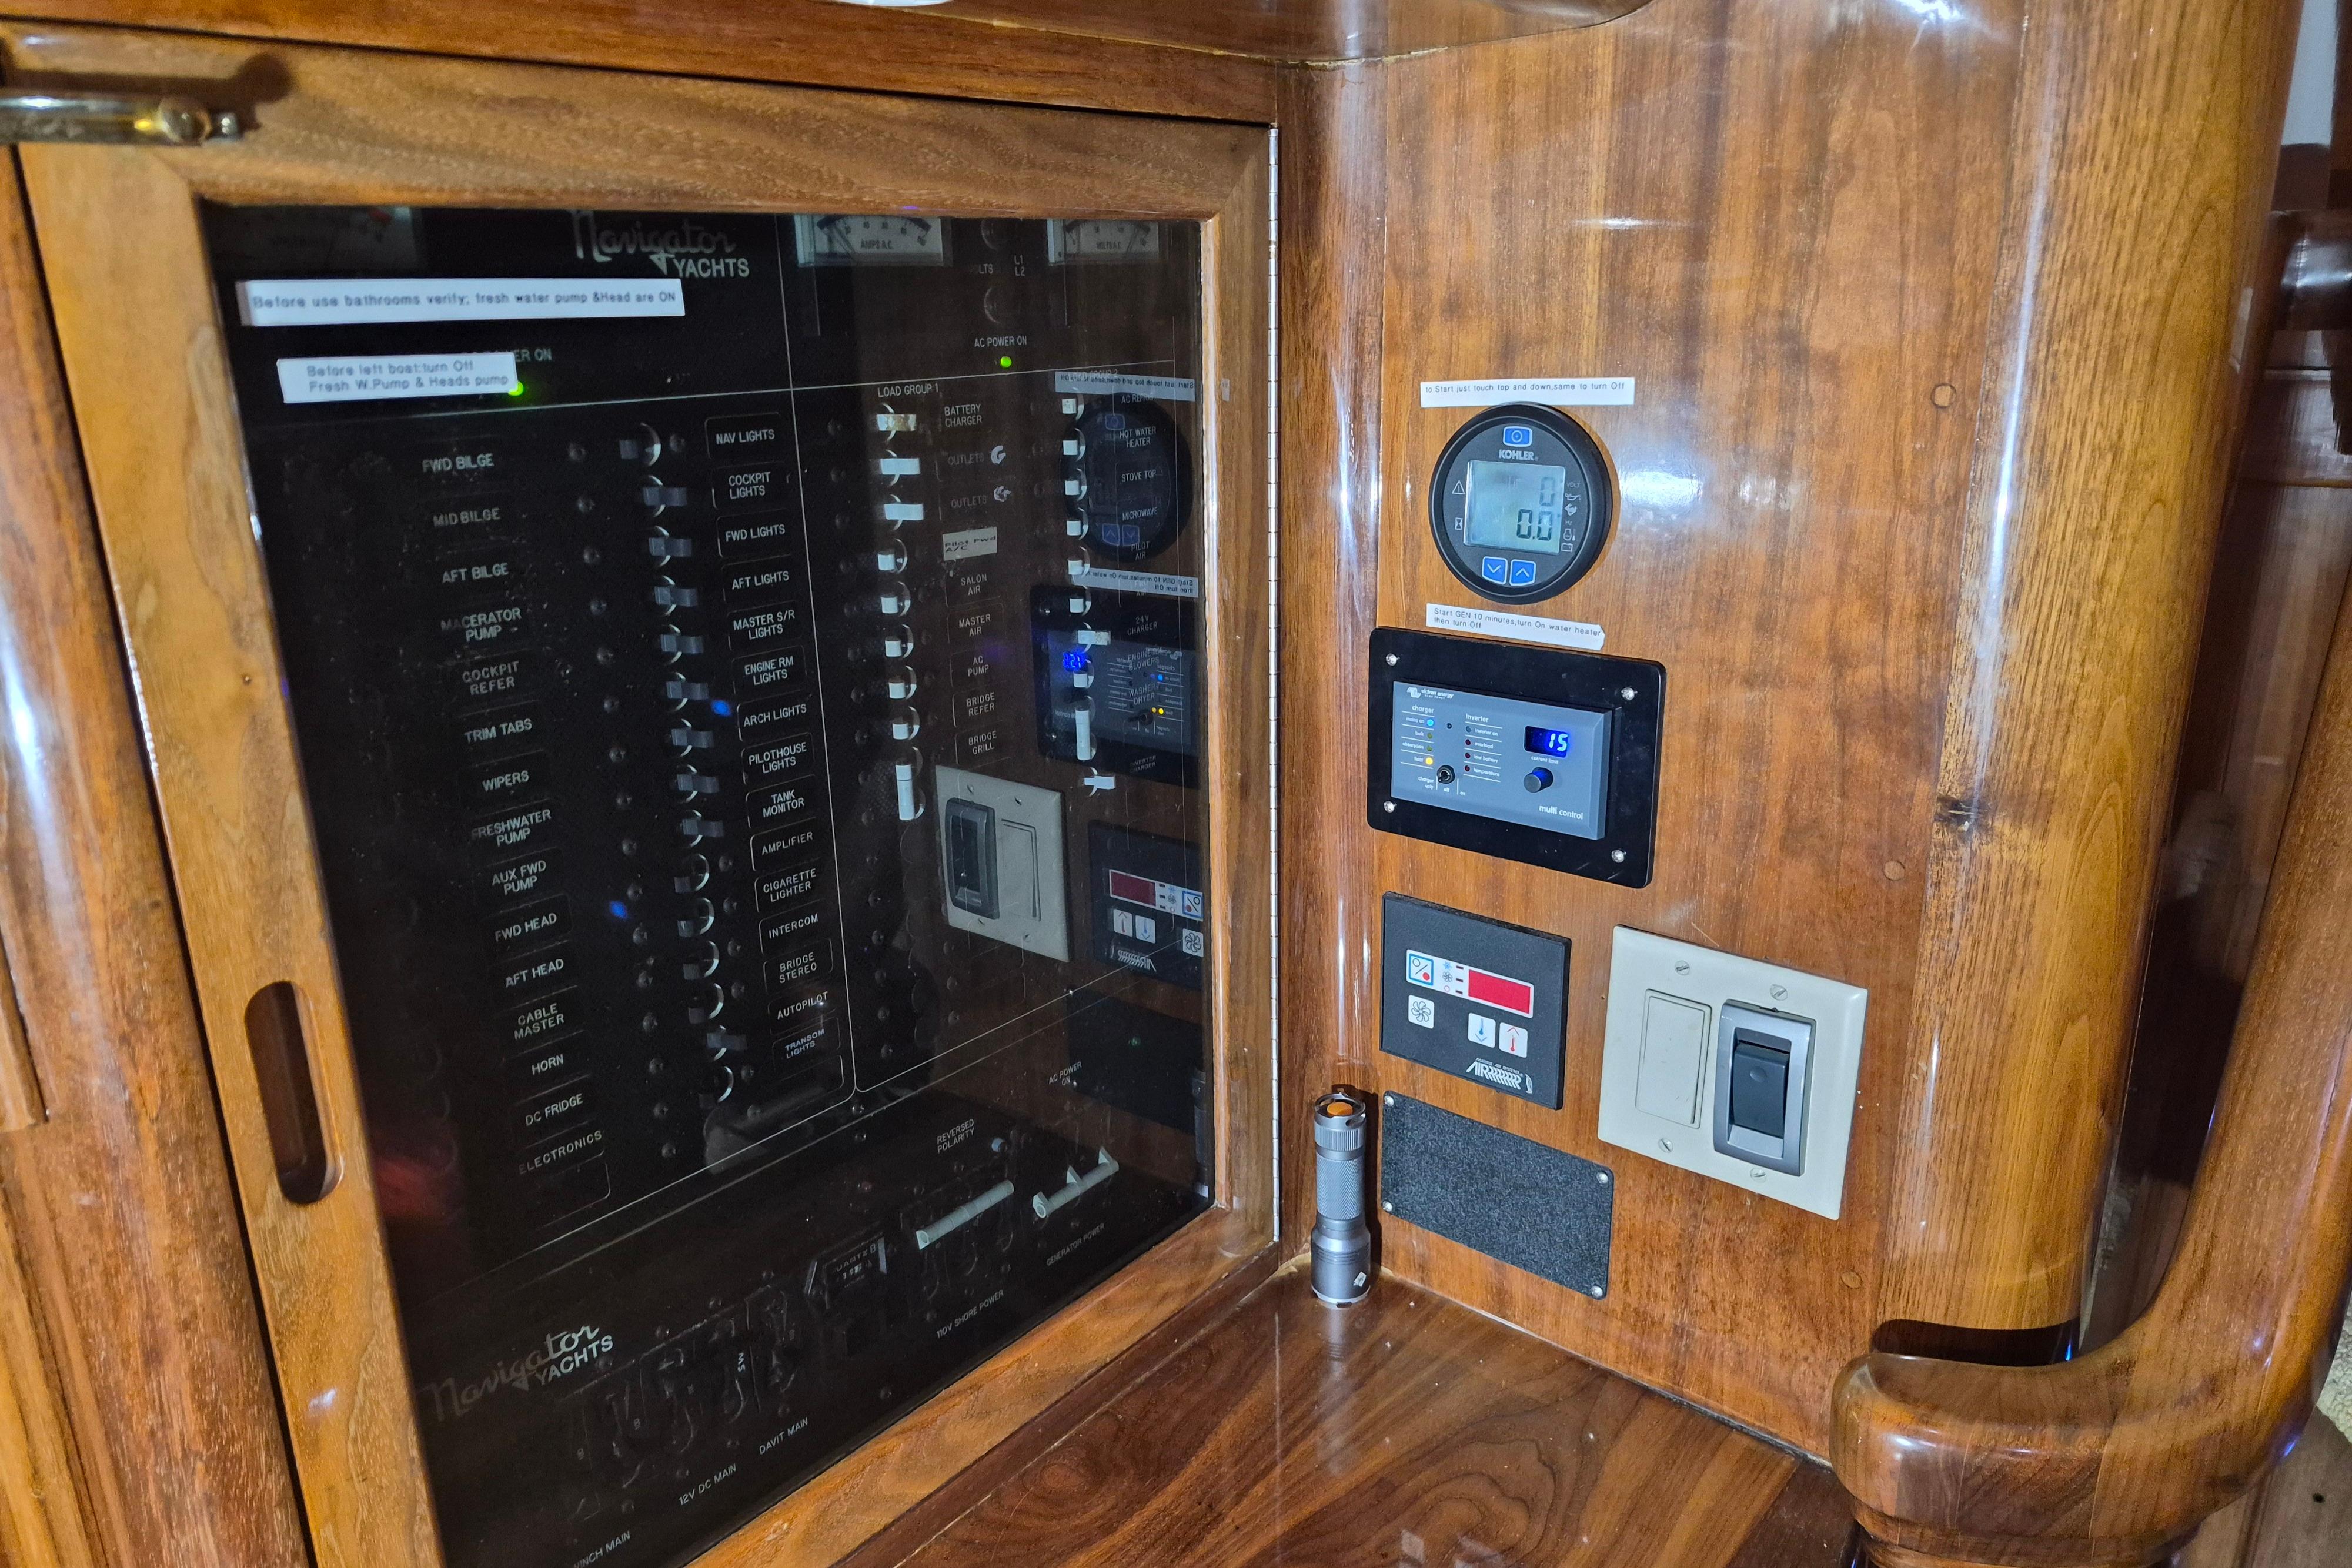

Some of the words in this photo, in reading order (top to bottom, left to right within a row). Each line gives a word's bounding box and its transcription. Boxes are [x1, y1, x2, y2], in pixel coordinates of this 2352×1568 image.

[674, 258, 750, 277] YACHTS
[1015, 266, 1025, 276] L2
[253, 295, 306, 308] Before
[312, 296, 338, 307] use
[344, 294, 420, 306] bathrooms
[476, 293, 509, 303] fresh
[515, 293, 548, 303] water
[555, 293, 587, 303] pump
[636, 293, 654, 303] are
[659, 291, 676, 302] ON
[974, 338, 985, 348] AC
[987, 337, 1014, 347] POWER
[1017, 336, 1027, 346] ON
[307, 365, 354, 377] Before
[359, 363, 382, 375] left
[453, 360, 473, 372] Off
[309, 380, 349, 392] Fresh
[416, 376, 424, 388] &
[429, 375, 469, 387] Heads
[475, 376, 509, 386] pump
[878, 386, 901, 398] LOAD
[904, 384, 932, 395] GROUP
[934, 383, 939, 393] 1
[1456, 385, 1471, 393] just
[944, 403, 981, 417] BATTERY
[945, 414, 983, 428] CHARGER
[716, 432, 736, 445] NAV
[739, 429, 775, 443] LIGHTS
[1126, 438, 1151, 448] HEATER
[422, 457, 453, 472] FWD
[456, 453, 494, 469] BILGE
[948, 452, 984, 466] OUTLETS
[1498, 449, 1535, 461] KOHLER
[728, 471, 771, 487] COCKPIT
[1121, 470, 1142, 482] STOVE
[1144, 469, 1157, 479] TOP
[729, 484, 766, 500] LIGHTS
[951, 494, 987, 509] OUTLETS
[433, 513, 459, 527] MID
[460, 507, 500, 524] BILGE
[1122, 507, 1158, 521] MICROWAVE
[725, 529, 747, 543] FWD
[750, 523, 786, 539] LIGHTS
[1516, 509, 1553, 541] 0.0
[1131, 540, 1150, 551] PILOT
[442, 567, 467, 583] AFT
[472, 563, 509, 580] BILGE
[731, 576, 751, 590] AFT
[754, 570, 790, 587] LIGHTS
[961, 573, 987, 586] SALON
[968, 585, 981, 596] AIR
[733, 613, 774, 631] MASTER
[776, 609, 795, 623] S/R
[958, 614, 991, 628] MASTER
[1127, 621, 1158, 636] CHARGER
[1434, 617, 1449, 625] then
[1434, 607, 1452, 617] Start
[1455, 610, 1471, 618] GEN
[1575, 627, 1601, 636] heater
[465, 625, 502, 643] PUMP
[749, 624, 783, 640] LIGHTS
[969, 626, 982, 637] AIR
[744, 658, 777, 676] ENGINE
[779, 656, 794, 668] RM
[968, 664, 990, 677] PUMP
[973, 656, 984, 666] AC
[462, 661, 519, 683] COCKPIT
[753, 668, 788, 686] LIGHTS
[470, 677, 515, 696] REFER
[966, 691, 995, 707] BRIDGE
[1134, 692, 1155, 705] DRYER
[743, 712, 771, 728] ARCH
[773, 703, 807, 721] LIGHTS
[968, 702, 995, 717] REFER
[1412, 704, 1435, 714] charger
[464, 726, 497, 744] TRIM
[500, 718, 532, 735] TABS
[968, 730, 997, 745] BRIDGE
[973, 742, 995, 755] GRILL
[1549, 733, 1569, 752] 15
[749, 741, 807, 766] PILOTHOUSE
[762, 756, 796, 774] LIGHTS
[482, 770, 529, 791] WIPERS
[771, 789, 796, 804] TANK
[763, 797, 805, 818] MONITOR
[1539, 805, 1558, 815] multi
[1559, 809, 1583, 820] control
[496, 827, 531, 847] PUMP
[761, 831, 813, 856] AMPLIFIER
[492, 868, 517, 887] AUX
[520, 860, 547, 877] FWD
[763, 868, 817, 894] CIGARETTE
[503, 875, 537, 895] PUMP
[770, 881, 811, 903] LIGHTER
[495, 924, 522, 942] FWD
[524, 912, 557, 933] HEAD
[769, 913, 818, 940] INTERCOM
[780, 952, 815, 973] BRIDGE
[505, 969, 528, 988] AFT
[532, 958, 564, 979] HEAD
[779, 962, 817, 984] STEREO
[517, 1002, 559, 1027] CABLE
[777, 991, 828, 1021] AUTOPILOT
[514, 1013, 564, 1041] MASTER
[784, 1029, 825, 1051] TRANSOM
[786, 1041, 816, 1059] LIGHTS
[531, 1053, 564, 1076] HORN
[1049, 1074, 1058, 1085] AC
[1059, 1061, 1082, 1079] POWER
[1062, 1076, 1070, 1085] ON
[525, 1111, 542, 1127] DC
[544, 1092, 584, 1119] FRIDGE
[936, 1118, 975, 1145] REVERSED
[937, 1127, 975, 1154] POLARITY
[518, 1130, 603, 1175] ELECTRONICS
[1046, 1236, 1083, 1267] GENERATOR
[1083, 1222, 1105, 1243] POWER
[954, 1307, 978, 1328] SHORE
[979, 1289, 1004, 1310] POWER
[535, 1335, 614, 1386] YACHTS
[421, 1325, 600, 1423] Navigator
[759, 1431, 785, 1456] DAVIT
[787, 1416, 809, 1438] MAIN
[679, 1488, 696, 1506] 12V
[698, 1478, 712, 1494] DC
[714, 1463, 737, 1485] MAIN
[606, 1530, 631, 1553] MAIN
